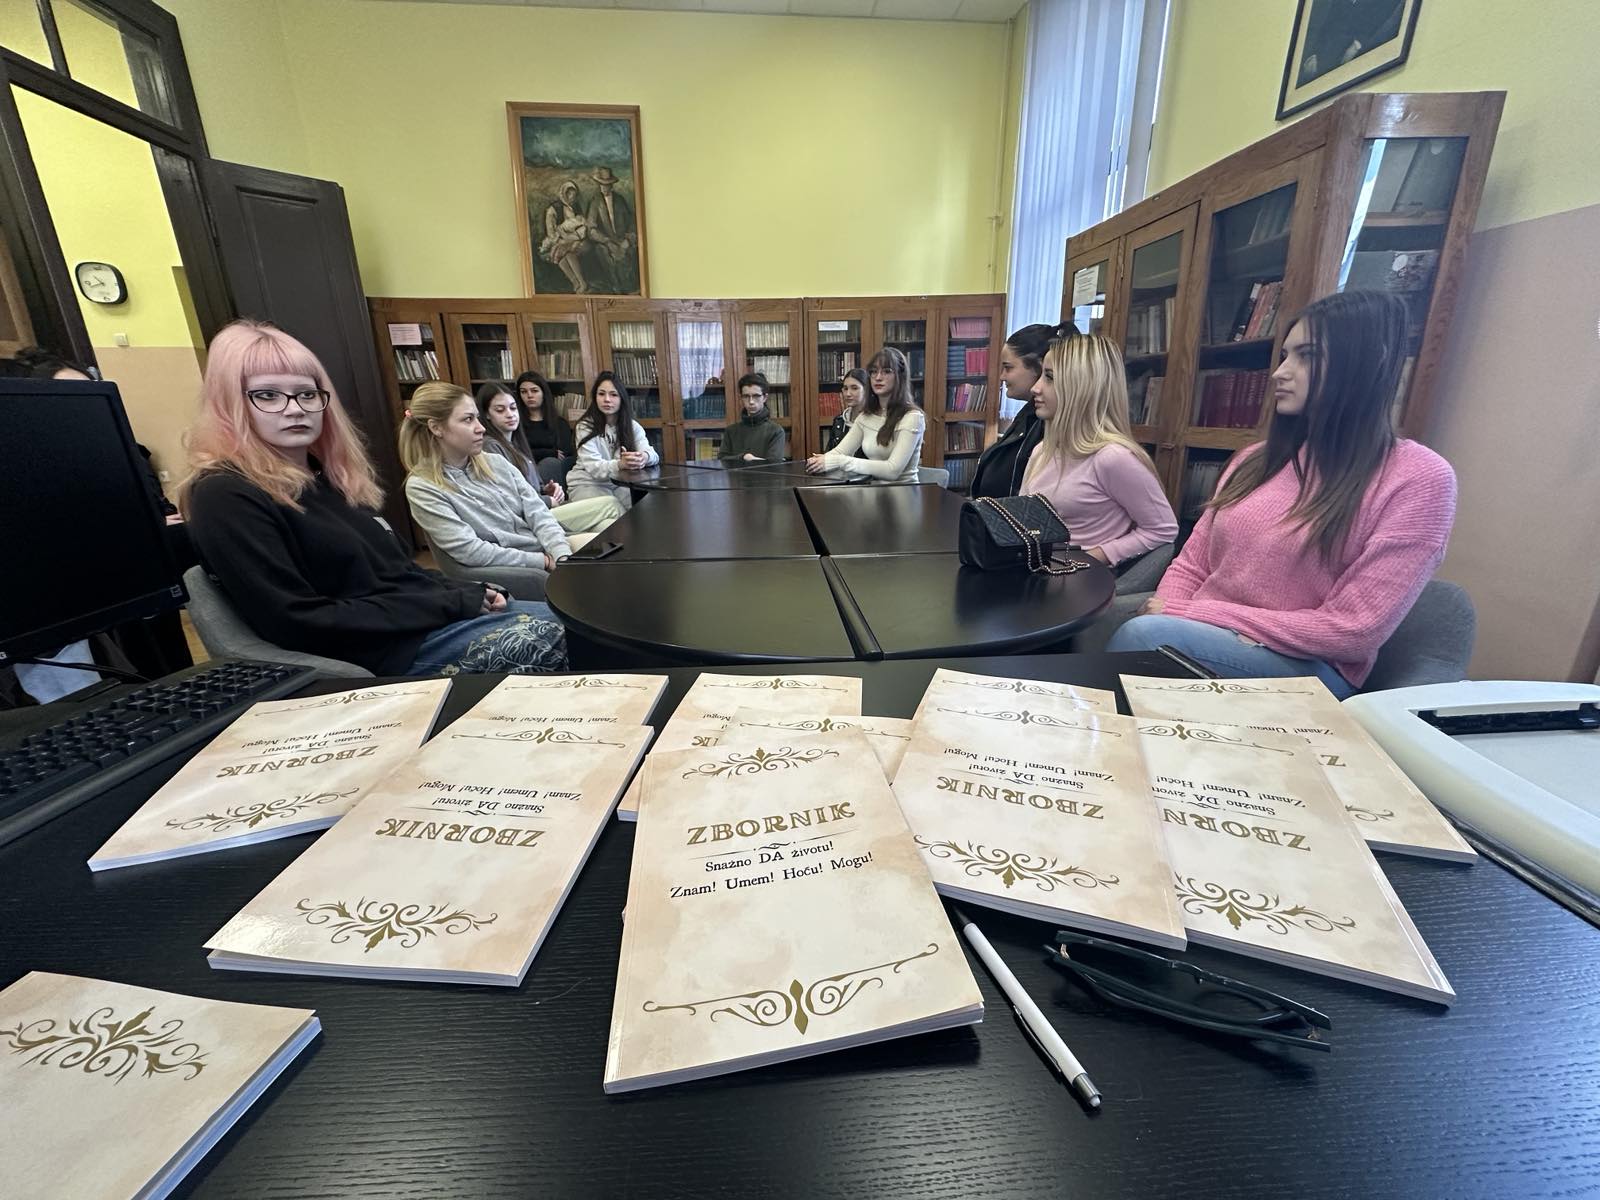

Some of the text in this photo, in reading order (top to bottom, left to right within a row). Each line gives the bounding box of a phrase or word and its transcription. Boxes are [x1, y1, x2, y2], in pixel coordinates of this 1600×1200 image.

[323, 728, 362, 739] Umem!
[1293, 726, 1335, 736] Znam!
[241, 739, 279, 748] Mogu!
[308, 739, 330, 748] DA
[944, 747, 978, 761] Mogu!
[215, 745, 379, 778] ZBORNIK
[1024, 761, 1067, 775] Umem!
[1013, 771, 1036, 782] DA
[1073, 768, 1115, 783] Znam!
[417, 780, 457, 792] Mogu!
[498, 787, 539, 799] Umem!
[1202, 783, 1252, 799] Umem!
[543, 790, 584, 802] Znam!
[935, 776, 1105, 820] ZBORNIK
[1193, 793, 1220, 806] DA
[1257, 791, 1307, 808] Znam!
[477, 800, 501, 811] DA
[686, 801, 856, 846] ZBORNIK
[375, 818, 547, 848] ZBORNIK
[758, 851, 785, 865] DA
[669, 881, 717, 899] Znam!
[725, 871, 775, 891] Umem!
[830, 851, 873, 872] Mogu!
